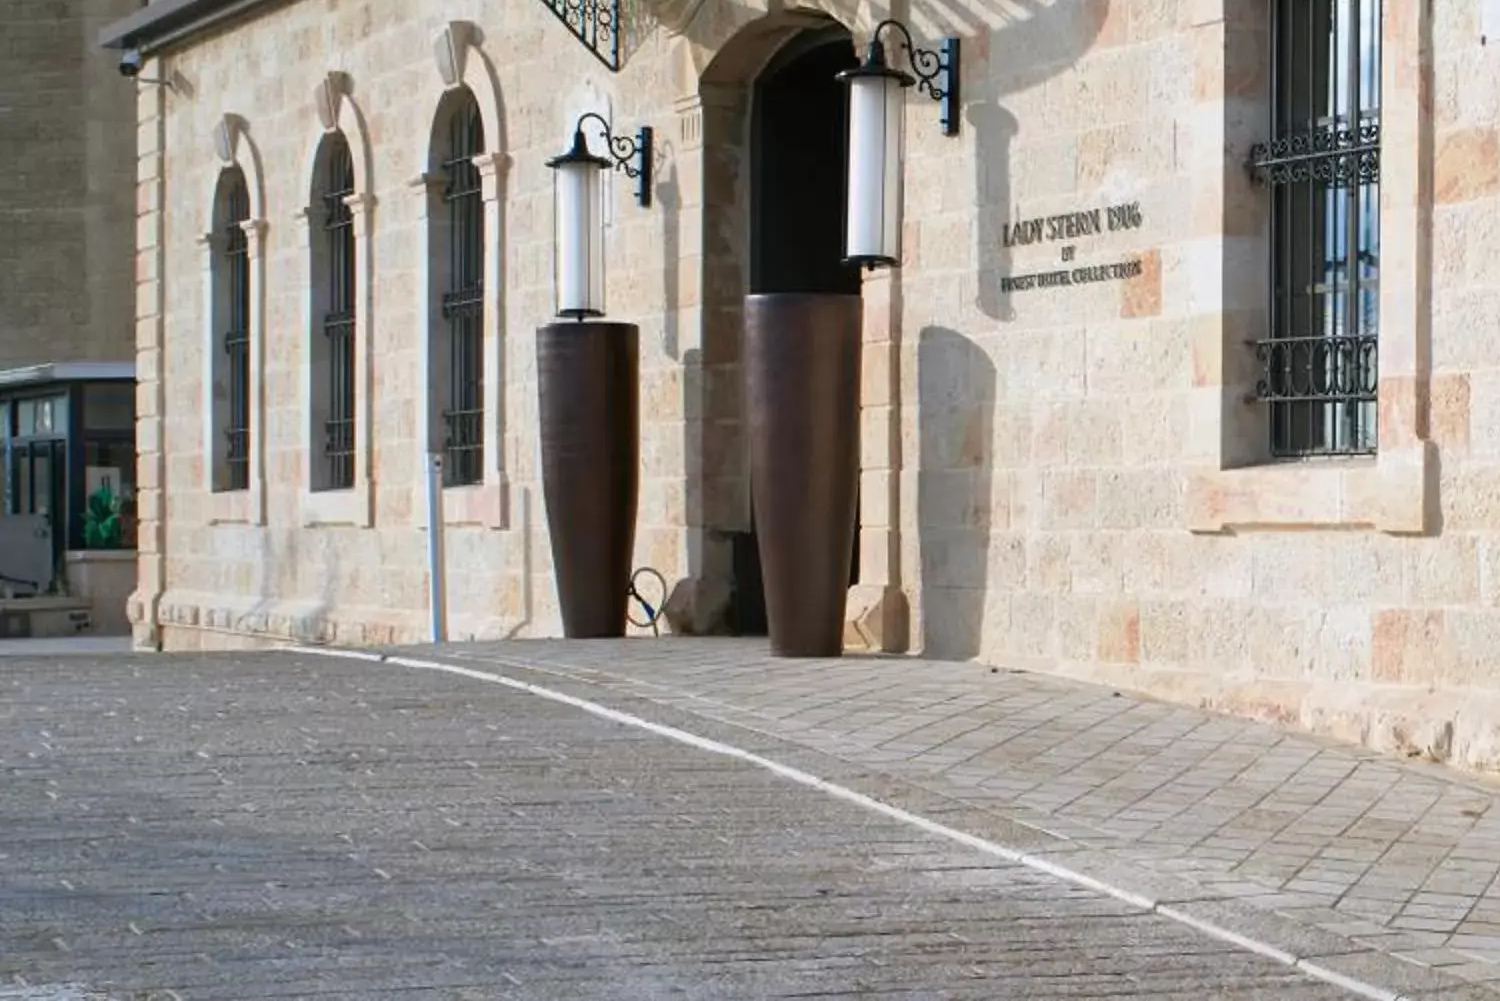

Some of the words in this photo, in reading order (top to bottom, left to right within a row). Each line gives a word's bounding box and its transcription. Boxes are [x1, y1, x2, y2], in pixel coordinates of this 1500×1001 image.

[1002, 217, 1044, 247] LADY
[1046, 208, 1101, 240] STERN
[1061, 246, 1076, 261] BY
